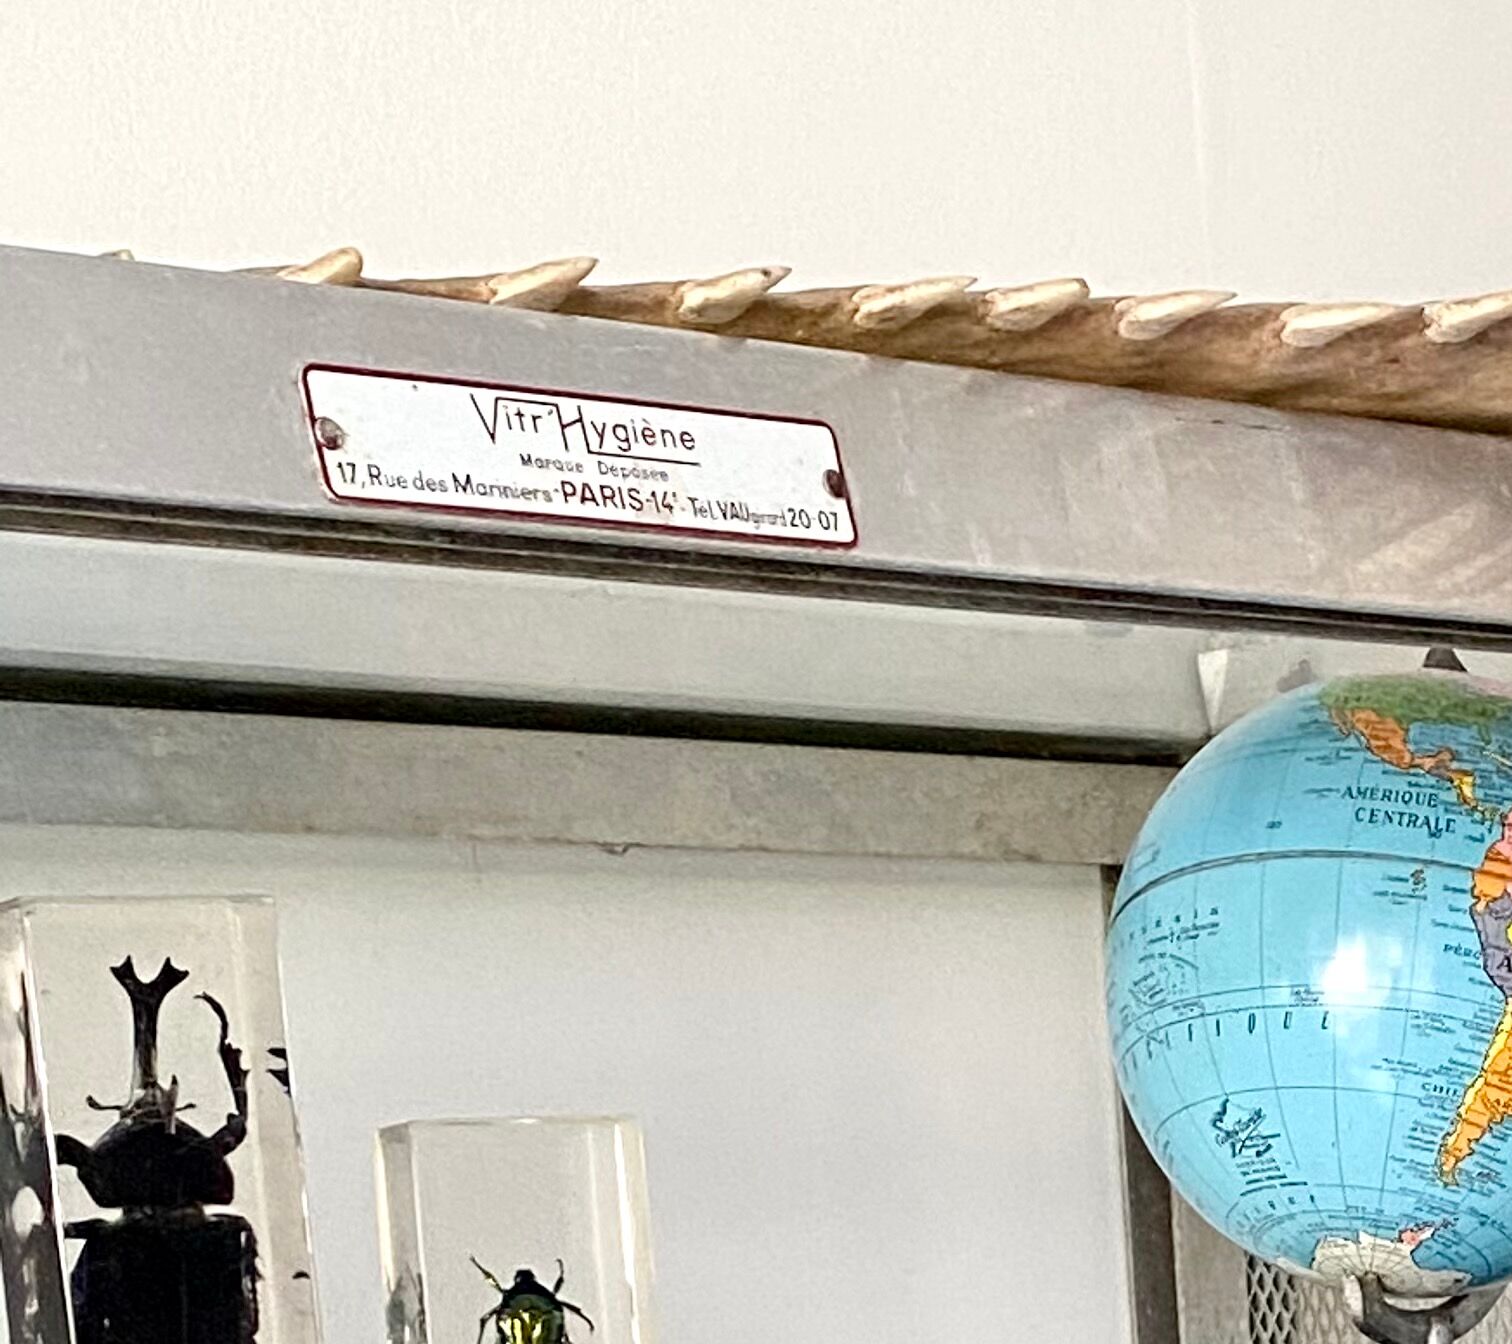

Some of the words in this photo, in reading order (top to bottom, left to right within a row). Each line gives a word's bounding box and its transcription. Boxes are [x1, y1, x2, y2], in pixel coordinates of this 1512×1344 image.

[367, 463, 409, 489] Rue
[412, 470, 449, 493] des
[519, 452, 585, 475] Marque
[1354, 806, 1456, 835] CENTRALE
